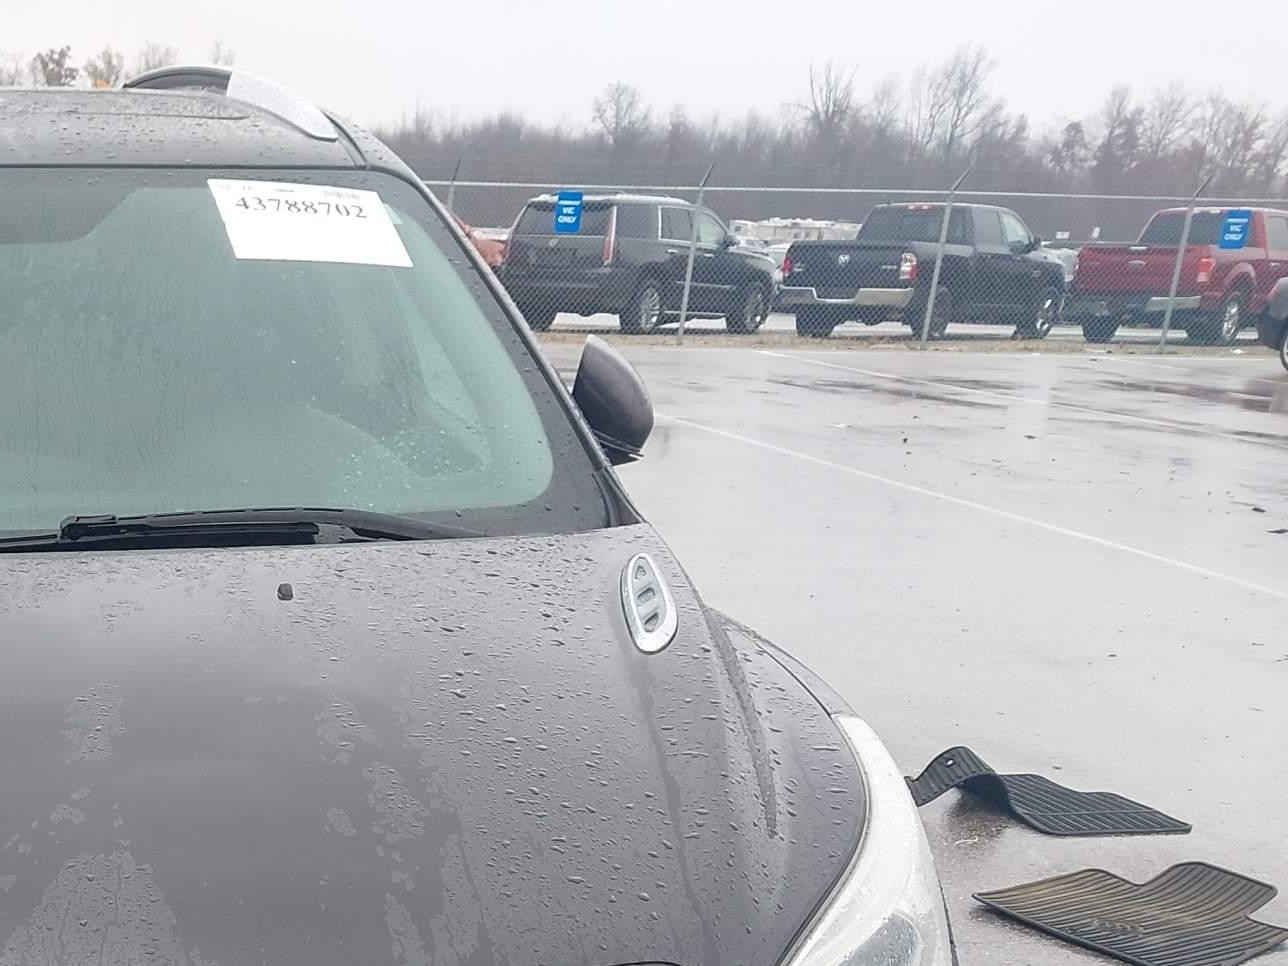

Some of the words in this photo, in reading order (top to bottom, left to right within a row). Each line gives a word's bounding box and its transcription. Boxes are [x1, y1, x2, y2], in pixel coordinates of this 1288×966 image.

[235, 196, 368, 219] 43788702
[562, 206, 575, 214] VIC
[557, 215, 578, 223] ONLY
